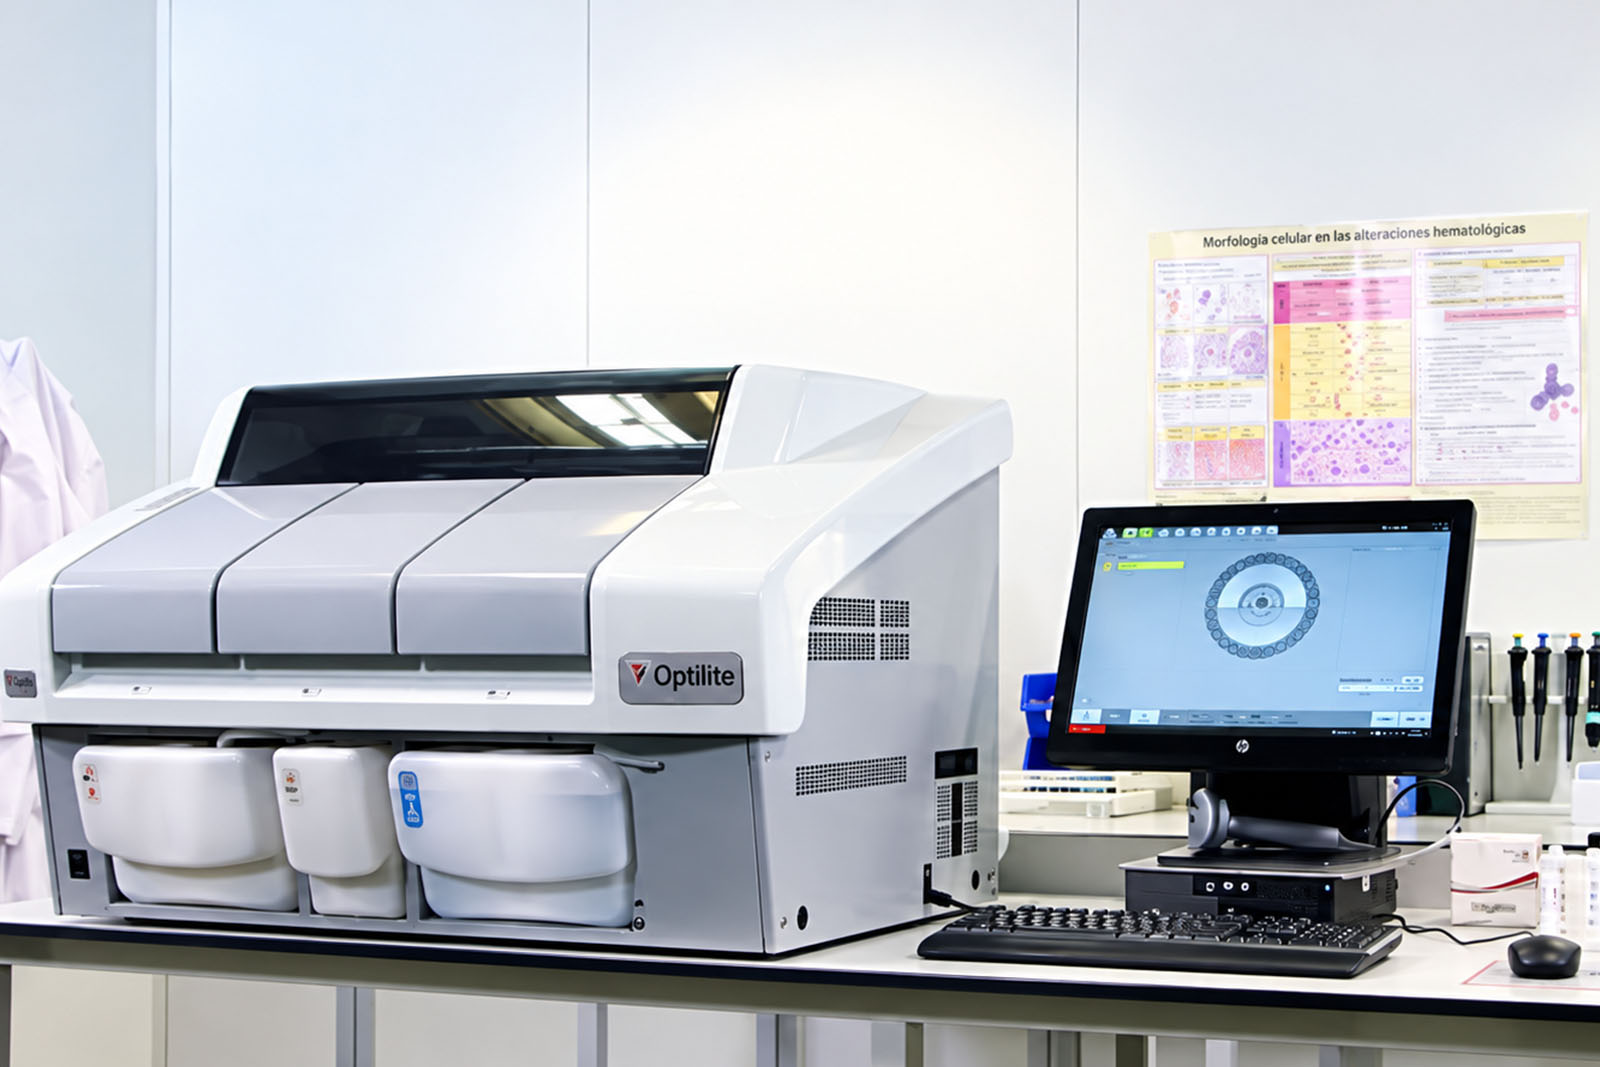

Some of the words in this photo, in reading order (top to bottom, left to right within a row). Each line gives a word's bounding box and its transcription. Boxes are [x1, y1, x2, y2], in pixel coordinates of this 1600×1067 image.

[1271, 231, 1313, 245] celular
[1315, 232, 1331, 243] en
[1333, 230, 1352, 242] las
[1354, 227, 1430, 241] alteraciones
[1433, 222, 1526, 238] hematológicas
[654, 664, 735, 692] Optilite
